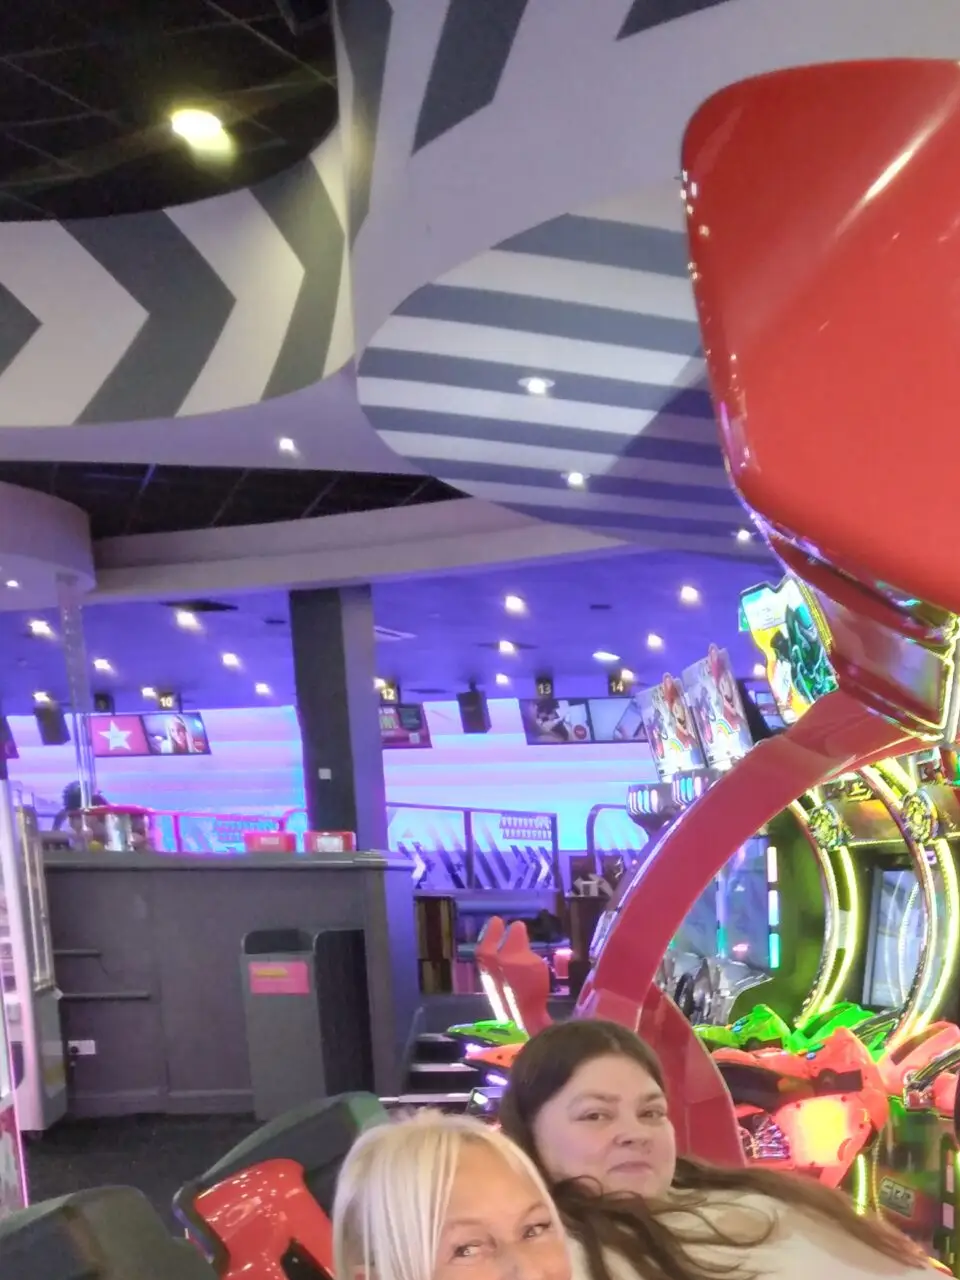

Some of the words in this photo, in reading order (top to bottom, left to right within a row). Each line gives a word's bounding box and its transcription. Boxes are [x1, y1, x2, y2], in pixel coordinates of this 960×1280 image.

[538, 682, 552, 695] 13
[610, 681, 624, 693] 14
[381, 687, 396, 701] 12
[160, 696, 173, 707] 10
